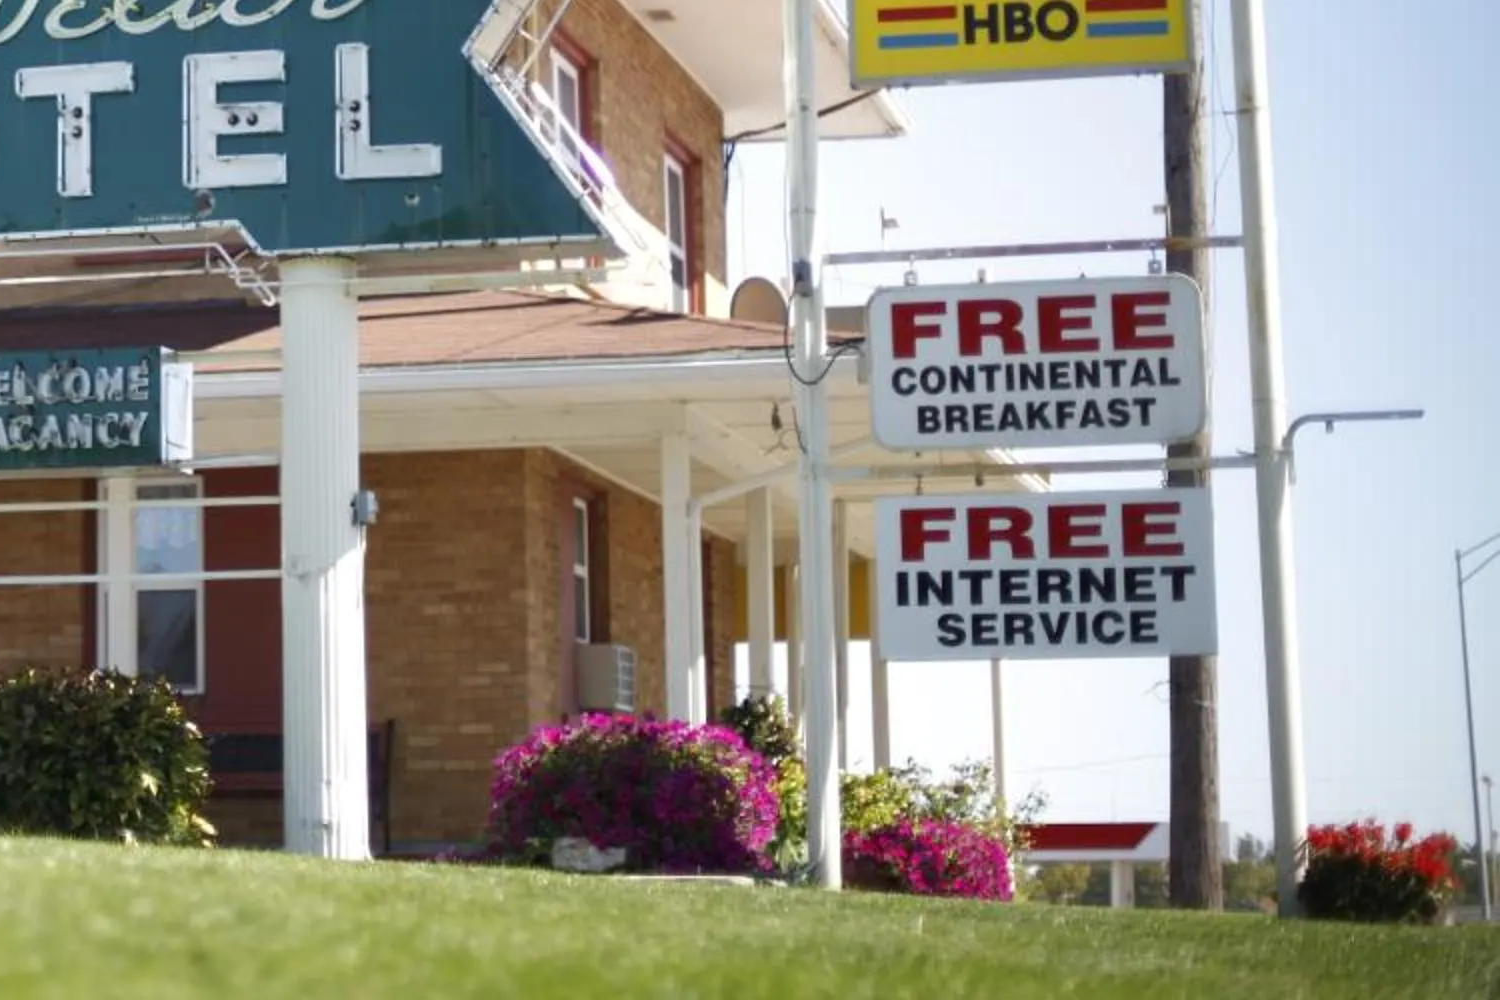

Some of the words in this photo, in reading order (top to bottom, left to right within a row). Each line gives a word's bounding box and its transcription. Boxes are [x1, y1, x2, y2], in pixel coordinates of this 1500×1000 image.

[963, 0, 1079, 45] HBO
[890, 291, 1175, 359] FREE
[891, 357, 1180, 396] CONTINENTAL
[917, 398, 1157, 434] BREAKFAST
[899, 501, 1185, 562] FREE
[895, 565, 1195, 607] INTERNET
[937, 610, 1159, 647] SERVICE
